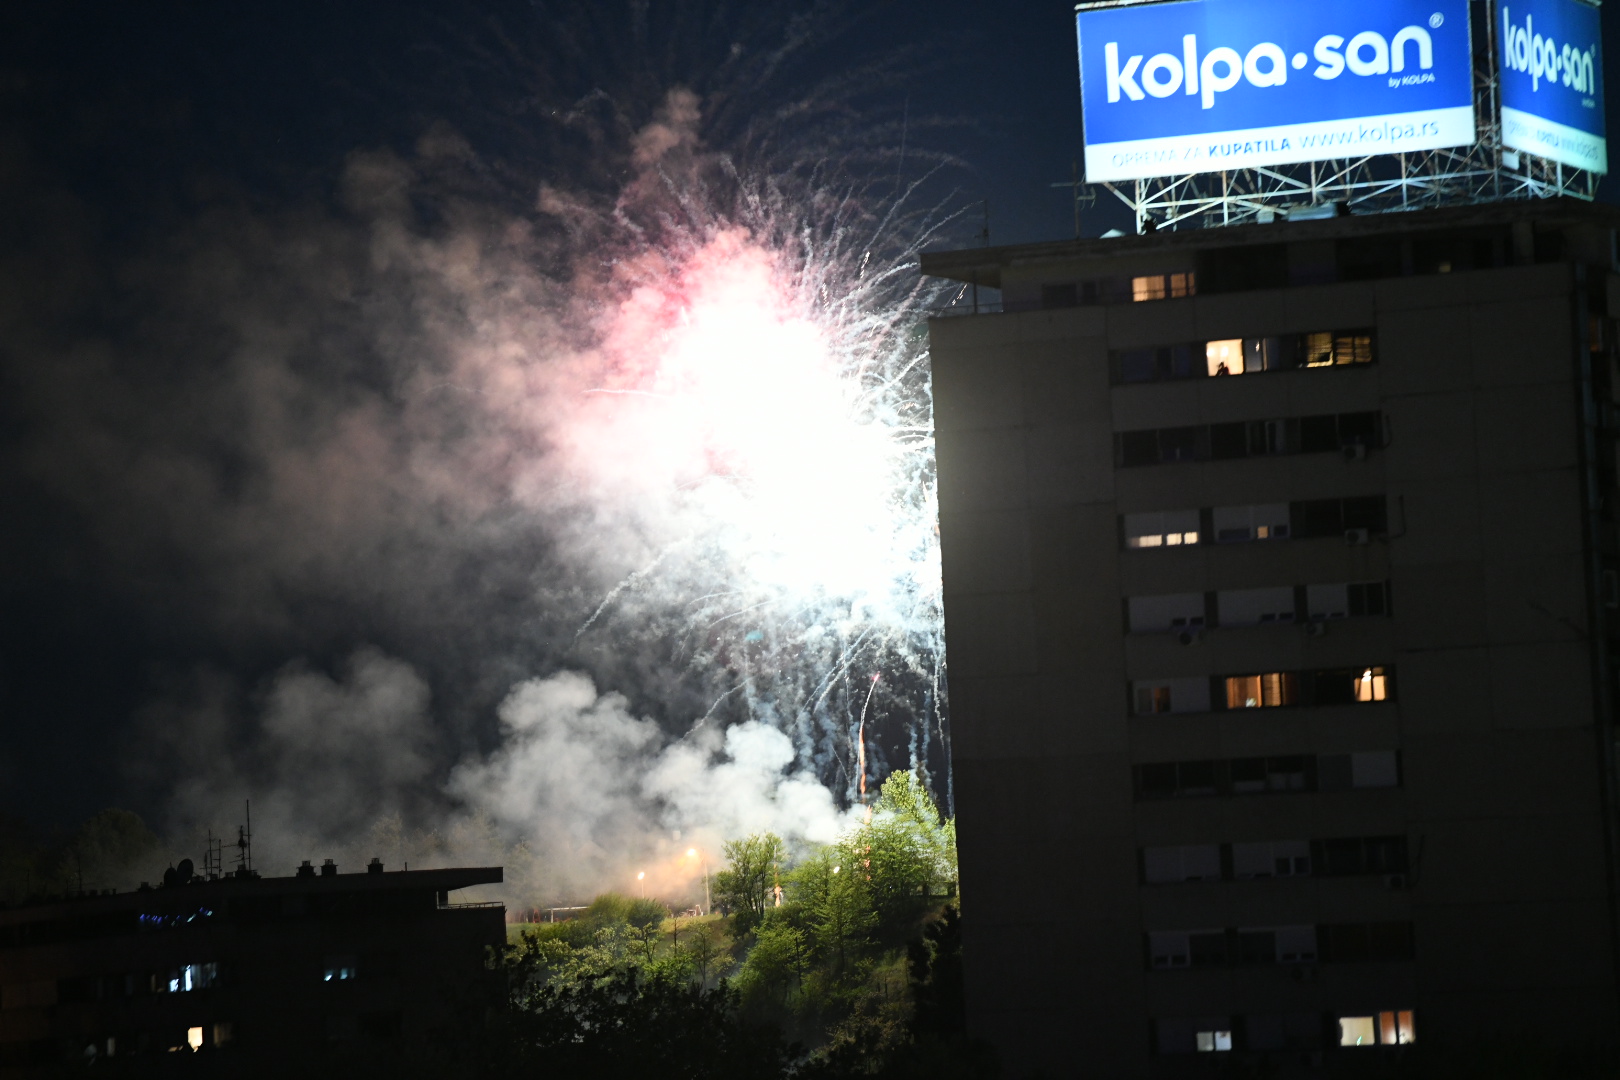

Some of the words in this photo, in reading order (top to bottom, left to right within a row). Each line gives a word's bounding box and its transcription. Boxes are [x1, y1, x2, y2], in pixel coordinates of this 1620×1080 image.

[1388, 76, 1401, 89] by
[1401, 72, 1436, 86] KOLPA
[1112, 148, 1178, 168] OPREMA
[1183, 146, 1204, 161] ZA
[1208, 137, 1291, 158] KUPATILA
[1300, 120, 1440, 148] www.kolpa.rs
